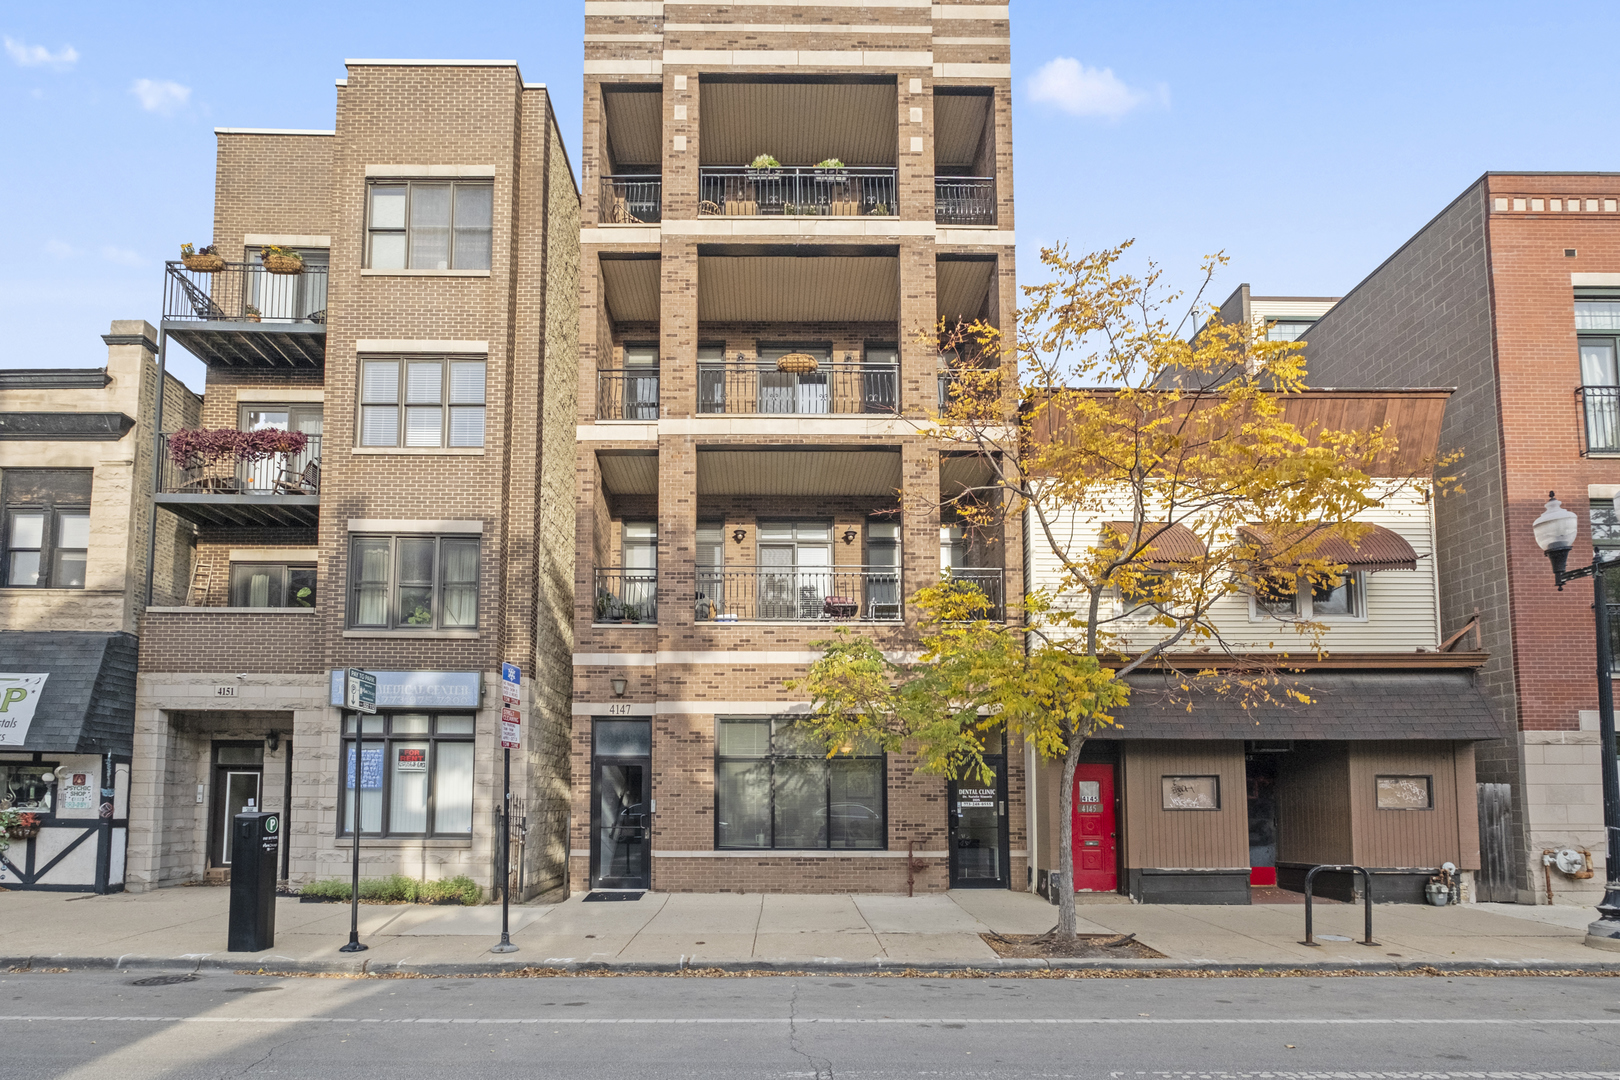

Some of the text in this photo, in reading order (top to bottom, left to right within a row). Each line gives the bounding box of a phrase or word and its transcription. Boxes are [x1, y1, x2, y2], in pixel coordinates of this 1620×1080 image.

[365, 674, 376, 683] PARK
[218, 687, 234, 696] 4151
[377, 684, 424, 694] MEDICAL
[426, 685, 468, 695] CENTER
[0, 688, 28, 712] P
[610, 704, 631, 714] 4147
